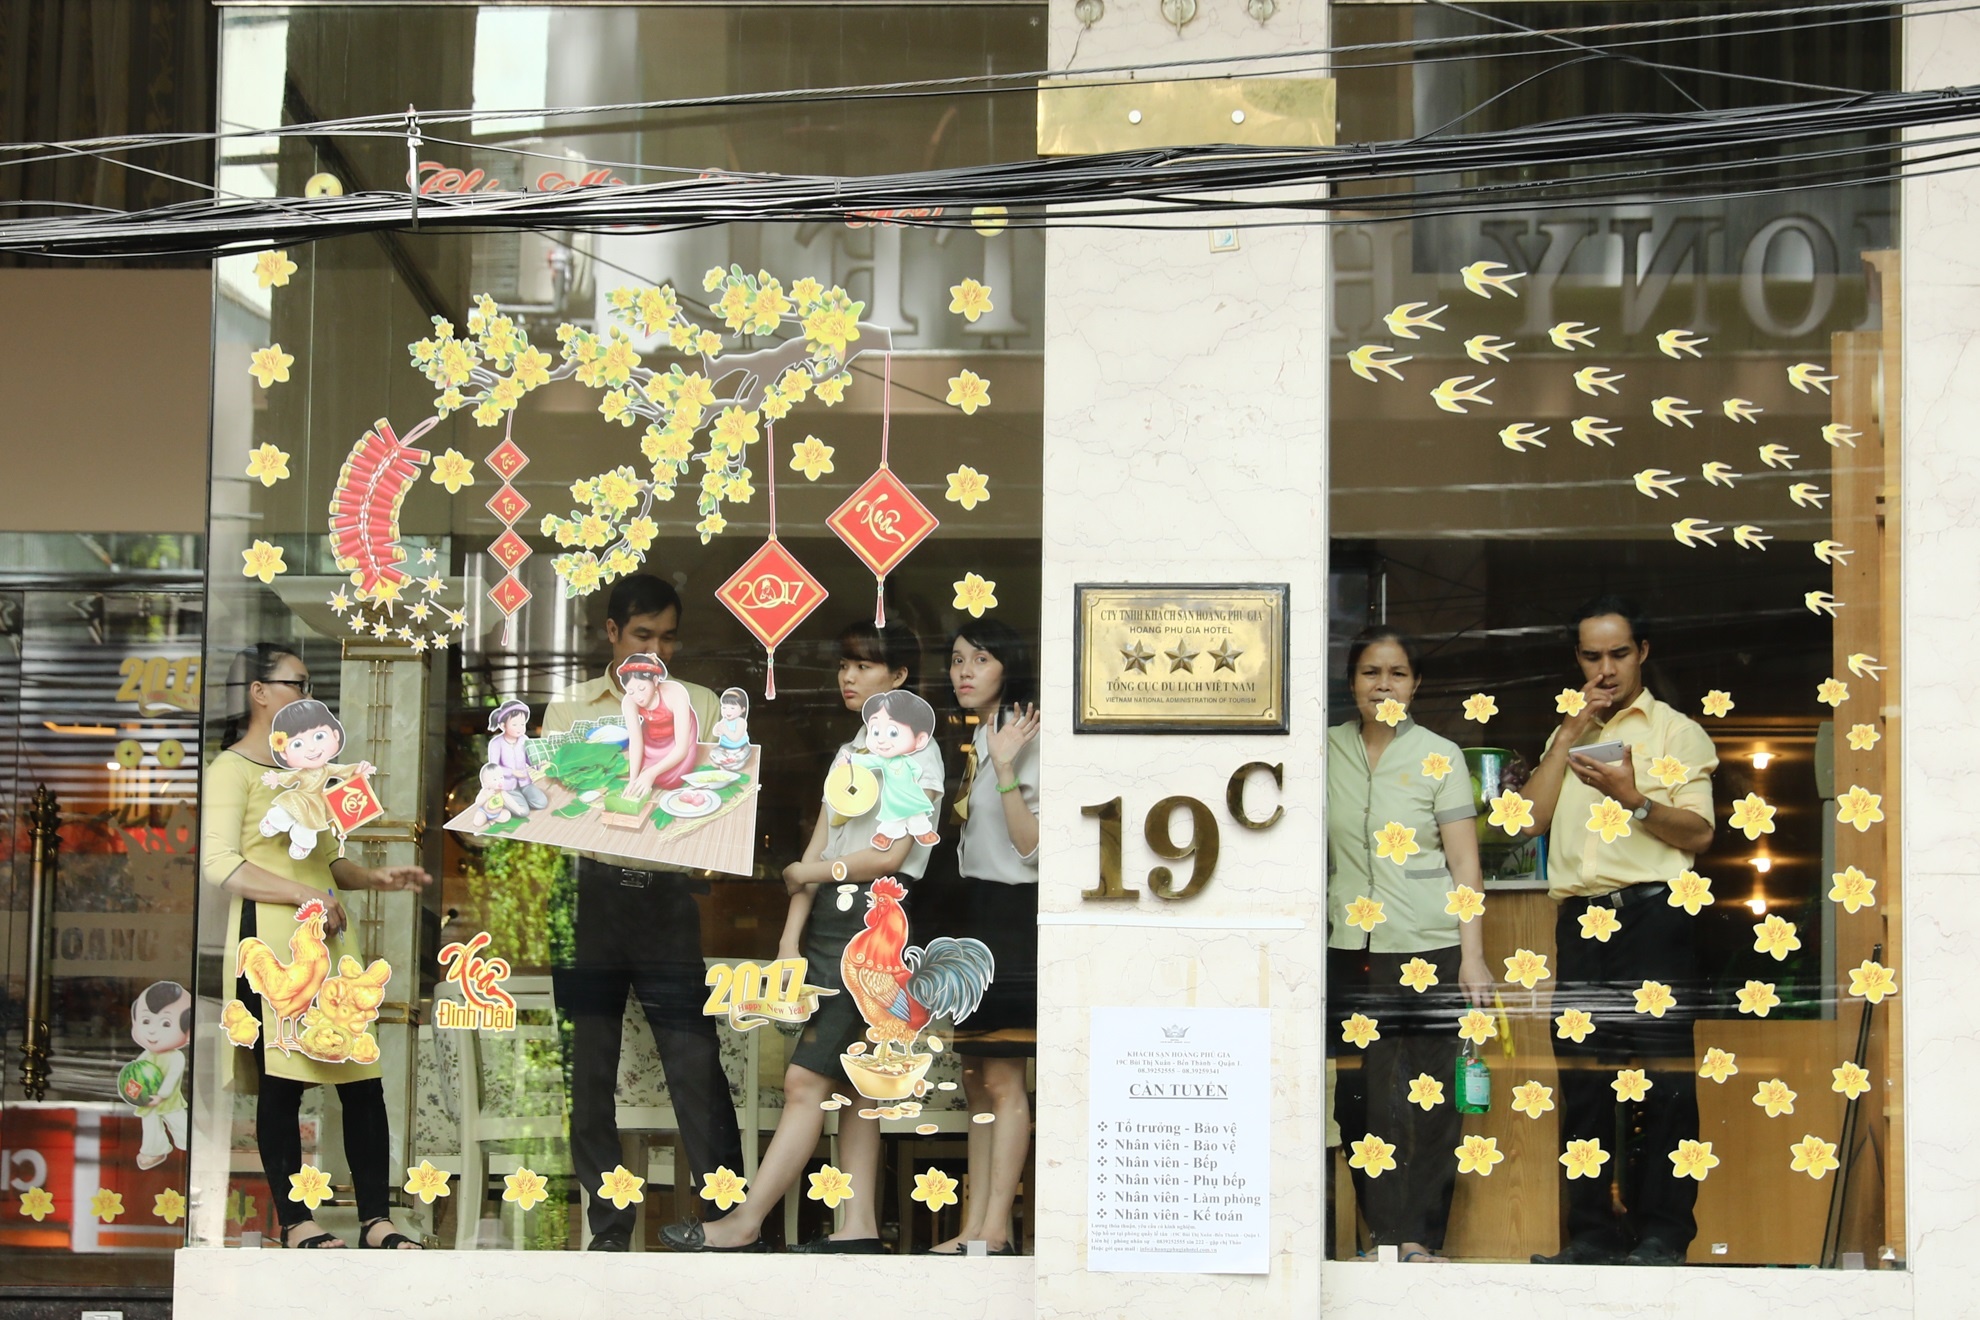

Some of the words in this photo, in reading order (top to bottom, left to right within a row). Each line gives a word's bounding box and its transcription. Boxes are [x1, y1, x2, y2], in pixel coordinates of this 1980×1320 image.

[737, 574, 805, 609] 2017
[1100, 610, 1117, 621] CTY
[1119, 610, 1142, 621] TNHH
[1178, 610, 1194, 623] SẠN
[1247, 610, 1263, 621] GIA
[1130, 626, 1162, 634] HOANG
[1164, 626, 1183, 634] PHU
[1186, 626, 1200, 634] GIA
[1204, 626, 1233, 634] HOTEL
[1106, 677, 1134, 692] TỔNG
[1138, 681, 1159, 693] CỤC
[1162, 681, 1176, 692] DU
[1178, 681, 1203, 693] LỊCH
[1206, 679, 1230, 693] VIỆT
[1232, 681, 1255, 692] NAM
[441, 935, 514, 1009] Xuân
[703, 958, 808, 1016] 2017
[438, 1002, 476, 1027] Đinh
[483, 1004, 514, 1030] Dậu
[738, 1002, 762, 1012] Happy
[767, 1004, 784, 1014] New
[788, 1004, 805, 1015] Year
[1129, 1080, 1165, 1096] CẦN
[1115, 1119, 1132, 1133] Tổ
[1136, 1122, 1181, 1136] trưởng
[1194, 1122, 1219, 1134] Bảo
[1223, 1123, 1237, 1136] vệ
[1115, 1139, 1149, 1151] Nhân
[1154, 1139, 1180, 1151] viên
[1194, 1140, 1218, 1151] Bảo
[1222, 1141, 1236, 1154] vệ
[1115, 1156, 1149, 1168] Nhân
[1154, 1157, 1180, 1168] viên
[1193, 1154, 1218, 1171] Bếp
[1115, 1174, 1149, 1186] Nhân
[1154, 1174, 1180, 1186] viên
[1193, 1174, 1218, 1189] Phụ
[1223, 1172, 1246, 1189] bếp
[1115, 1191, 1149, 1203] Nhân
[1154, 1192, 1180, 1203] viên
[1193, 1193, 1220, 1204] Làm
[1224, 1193, 1261, 1206] phòng
[1115, 1208, 1149, 1220] Nhân
[1154, 1209, 1180, 1220] viên
[1193, 1206, 1211, 1221] Kế
[1215, 1210, 1243, 1222] toán
